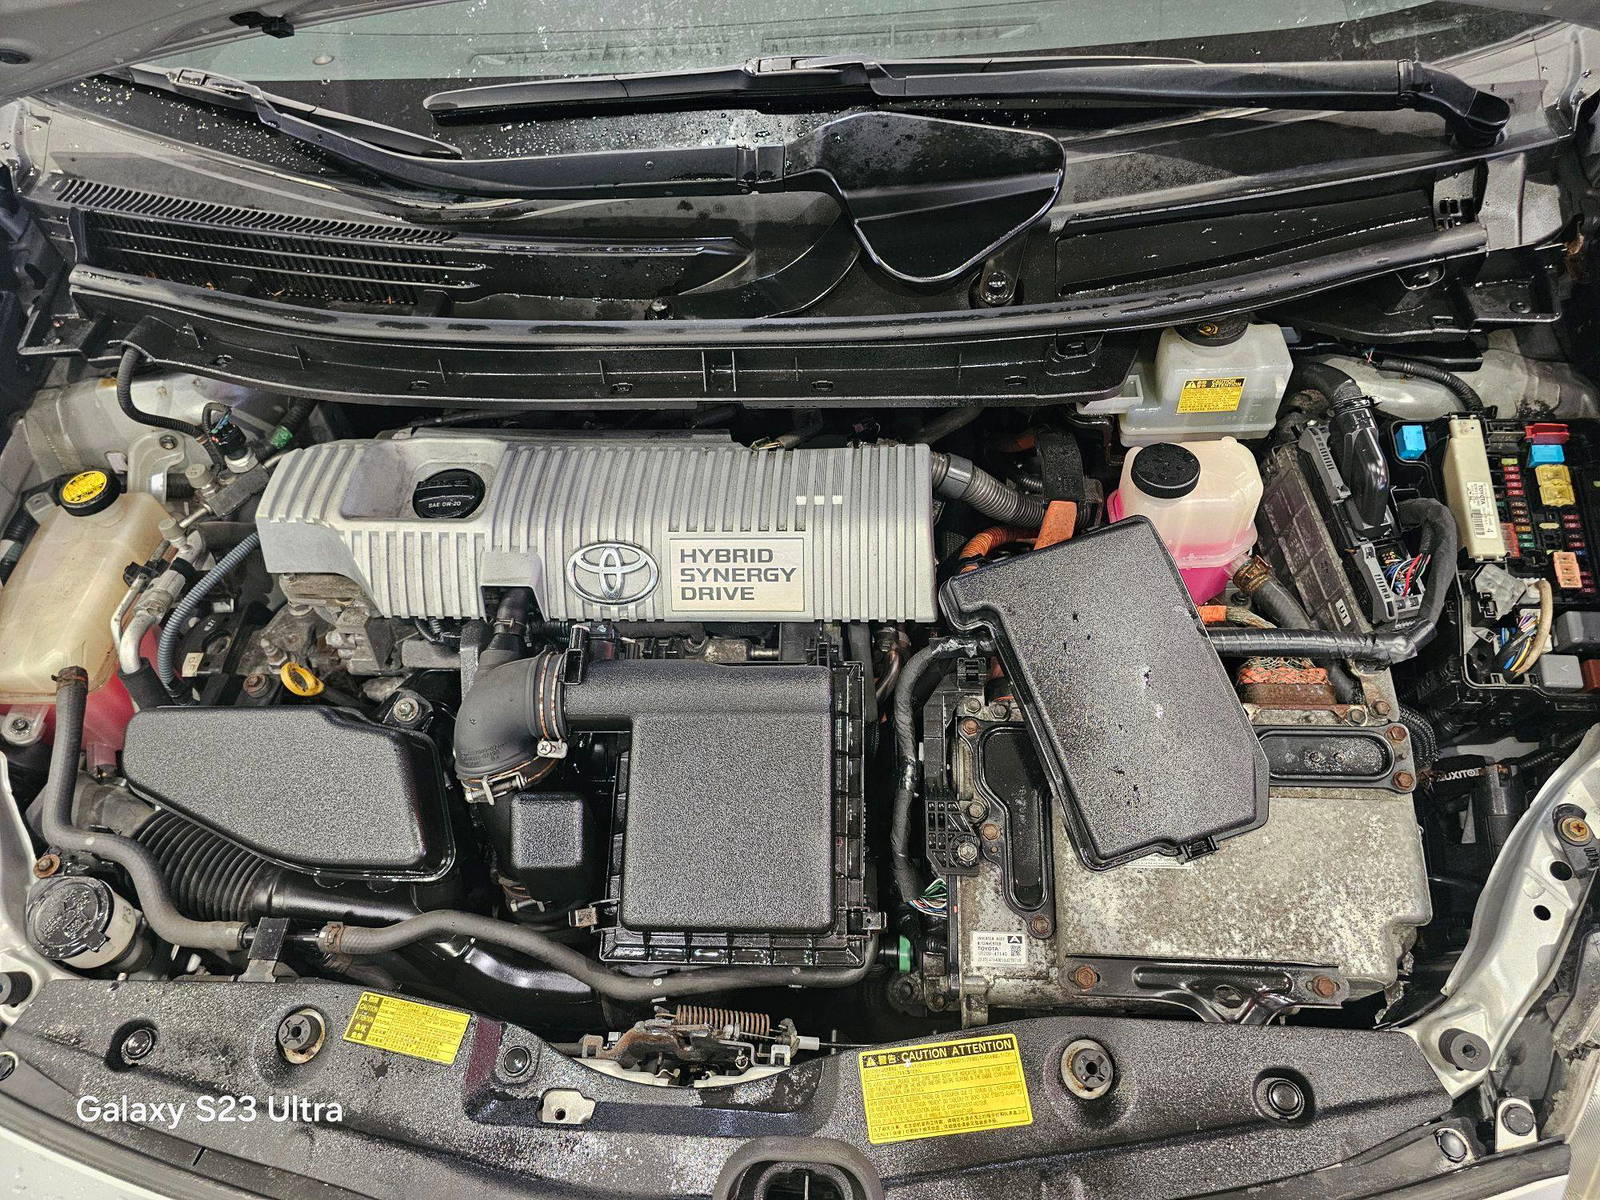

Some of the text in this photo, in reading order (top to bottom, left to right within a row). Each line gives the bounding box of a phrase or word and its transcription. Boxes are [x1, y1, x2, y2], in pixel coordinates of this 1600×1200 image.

[680, 548, 774, 564] HYBRID
[680, 567, 797, 583] SYNERGY
[680, 586, 755, 601] DRIVE
[901, 1039, 1012, 1063] CAUTION ATTENTION
